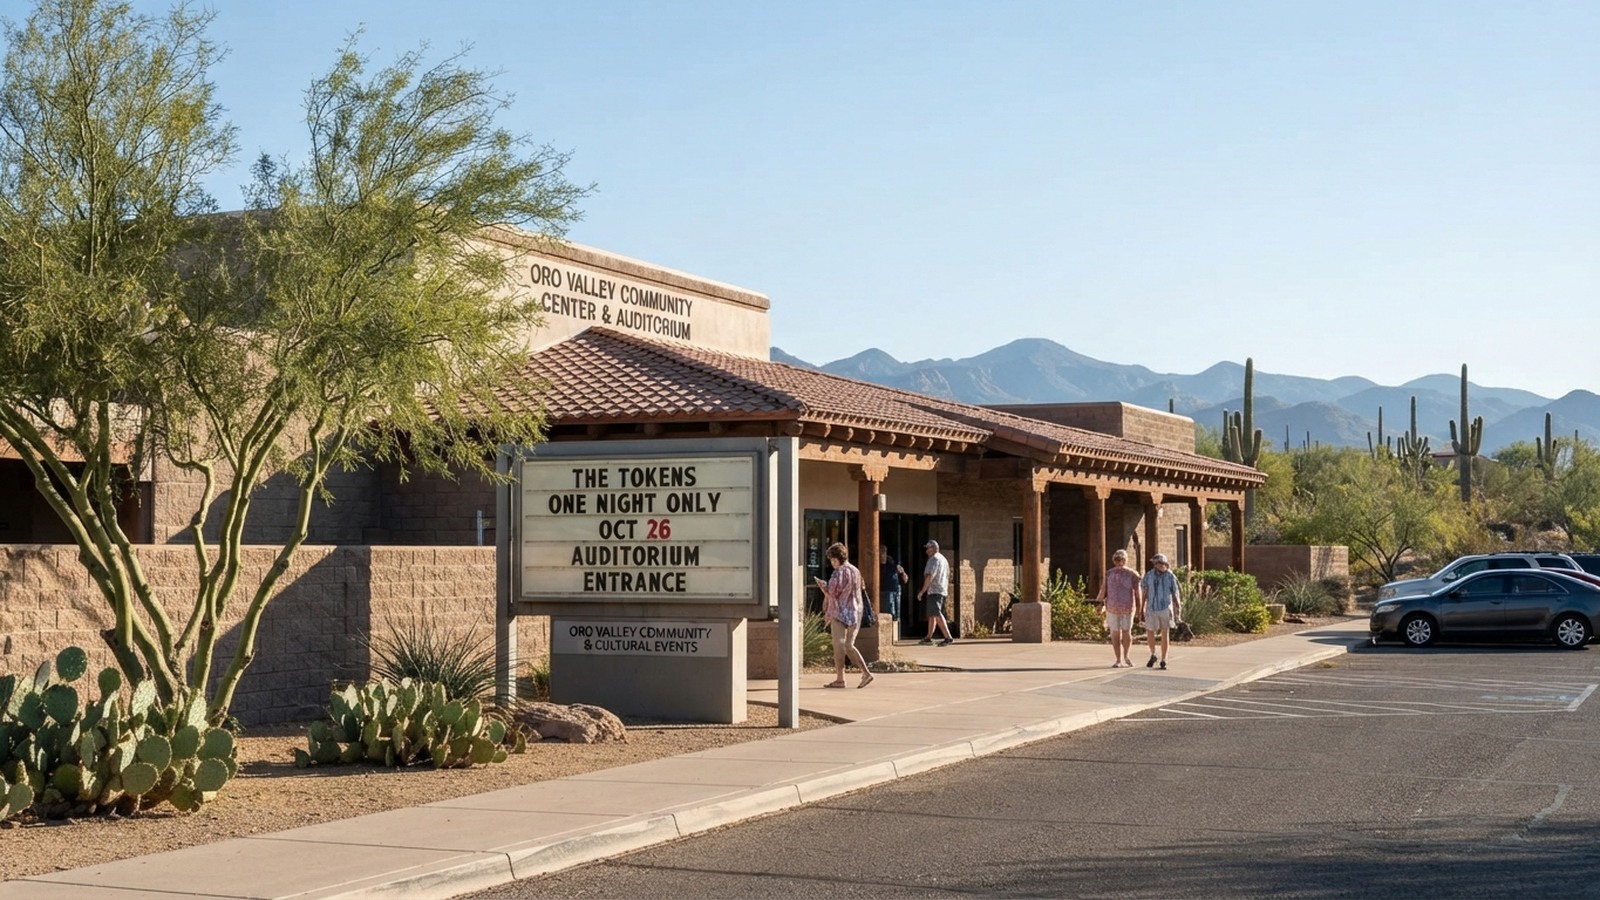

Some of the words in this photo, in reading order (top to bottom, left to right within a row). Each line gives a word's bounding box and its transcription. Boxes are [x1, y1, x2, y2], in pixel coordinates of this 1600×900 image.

[531, 263, 562, 288] ORO
[567, 271, 616, 300] VALLEY
[621, 284, 693, 317] COMMUNITY
[541, 292, 596, 321] CENTER
[602, 305, 612, 324] &
[572, 468, 609, 488] THE
[618, 466, 697, 488] TOKENS
[548, 494, 587, 514] ONE
[597, 492, 656, 514] NIGHT
[666, 492, 721, 513] ONLY
[599, 519, 638, 540] OCT
[646, 519, 671, 540] 26
[571, 545, 700, 566] AUDITORIUM
[583, 571, 687, 592] ENTRANCE
[569, 625, 593, 638] ORO
[595, 626, 637, 638] VALLEY
[583, 639, 593, 650] &
[595, 639, 653, 652] CULTURAL
[654, 641, 698, 653] EVENTS
